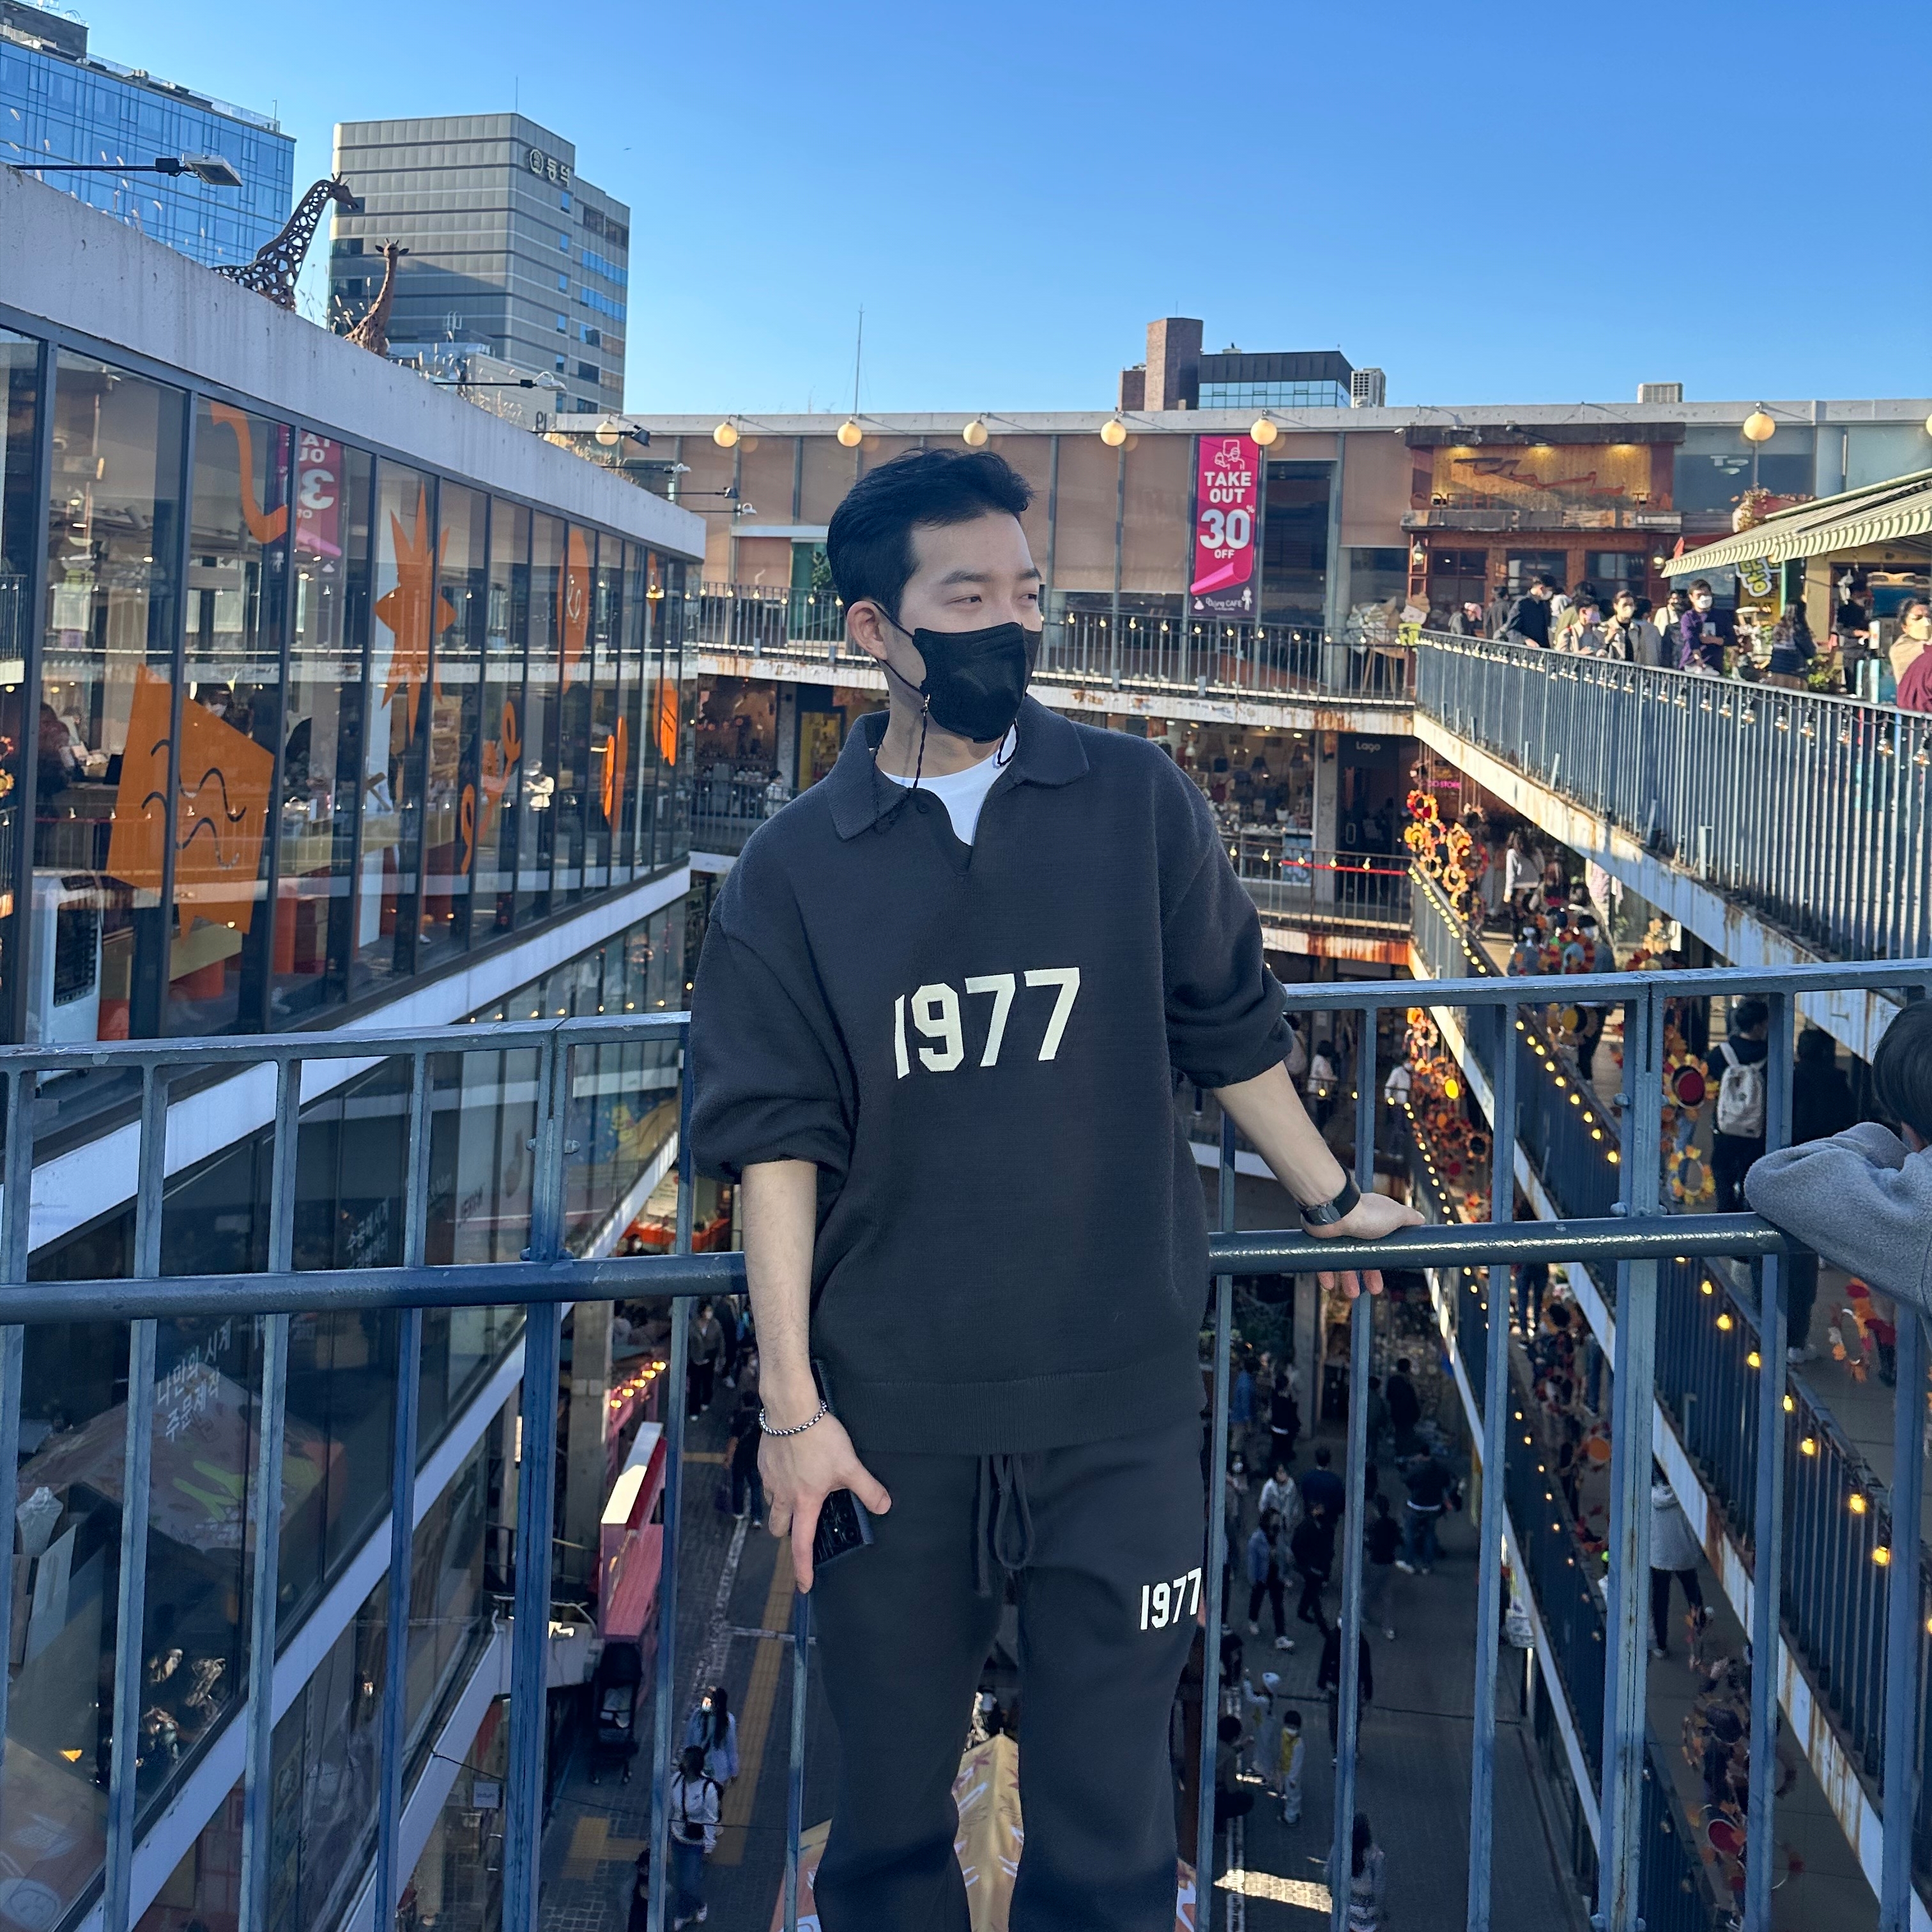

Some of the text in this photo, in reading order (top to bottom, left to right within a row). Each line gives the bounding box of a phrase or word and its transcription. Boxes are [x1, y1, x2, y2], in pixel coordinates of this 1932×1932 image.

[546, 157, 570, 188] 동덕
[1204, 471, 1252, 487] TAKE
[1209, 488, 1245, 503] OUT
[1214, 549, 1235, 559] OFF
[894, 967, 1080, 1080] 1977
[157, 1345, 200, 1407] 나만의
[204, 1317, 232, 1363] 시계
[165, 1366, 220, 1443] 주문제작
[1140, 1567, 1202, 1630] 1977
